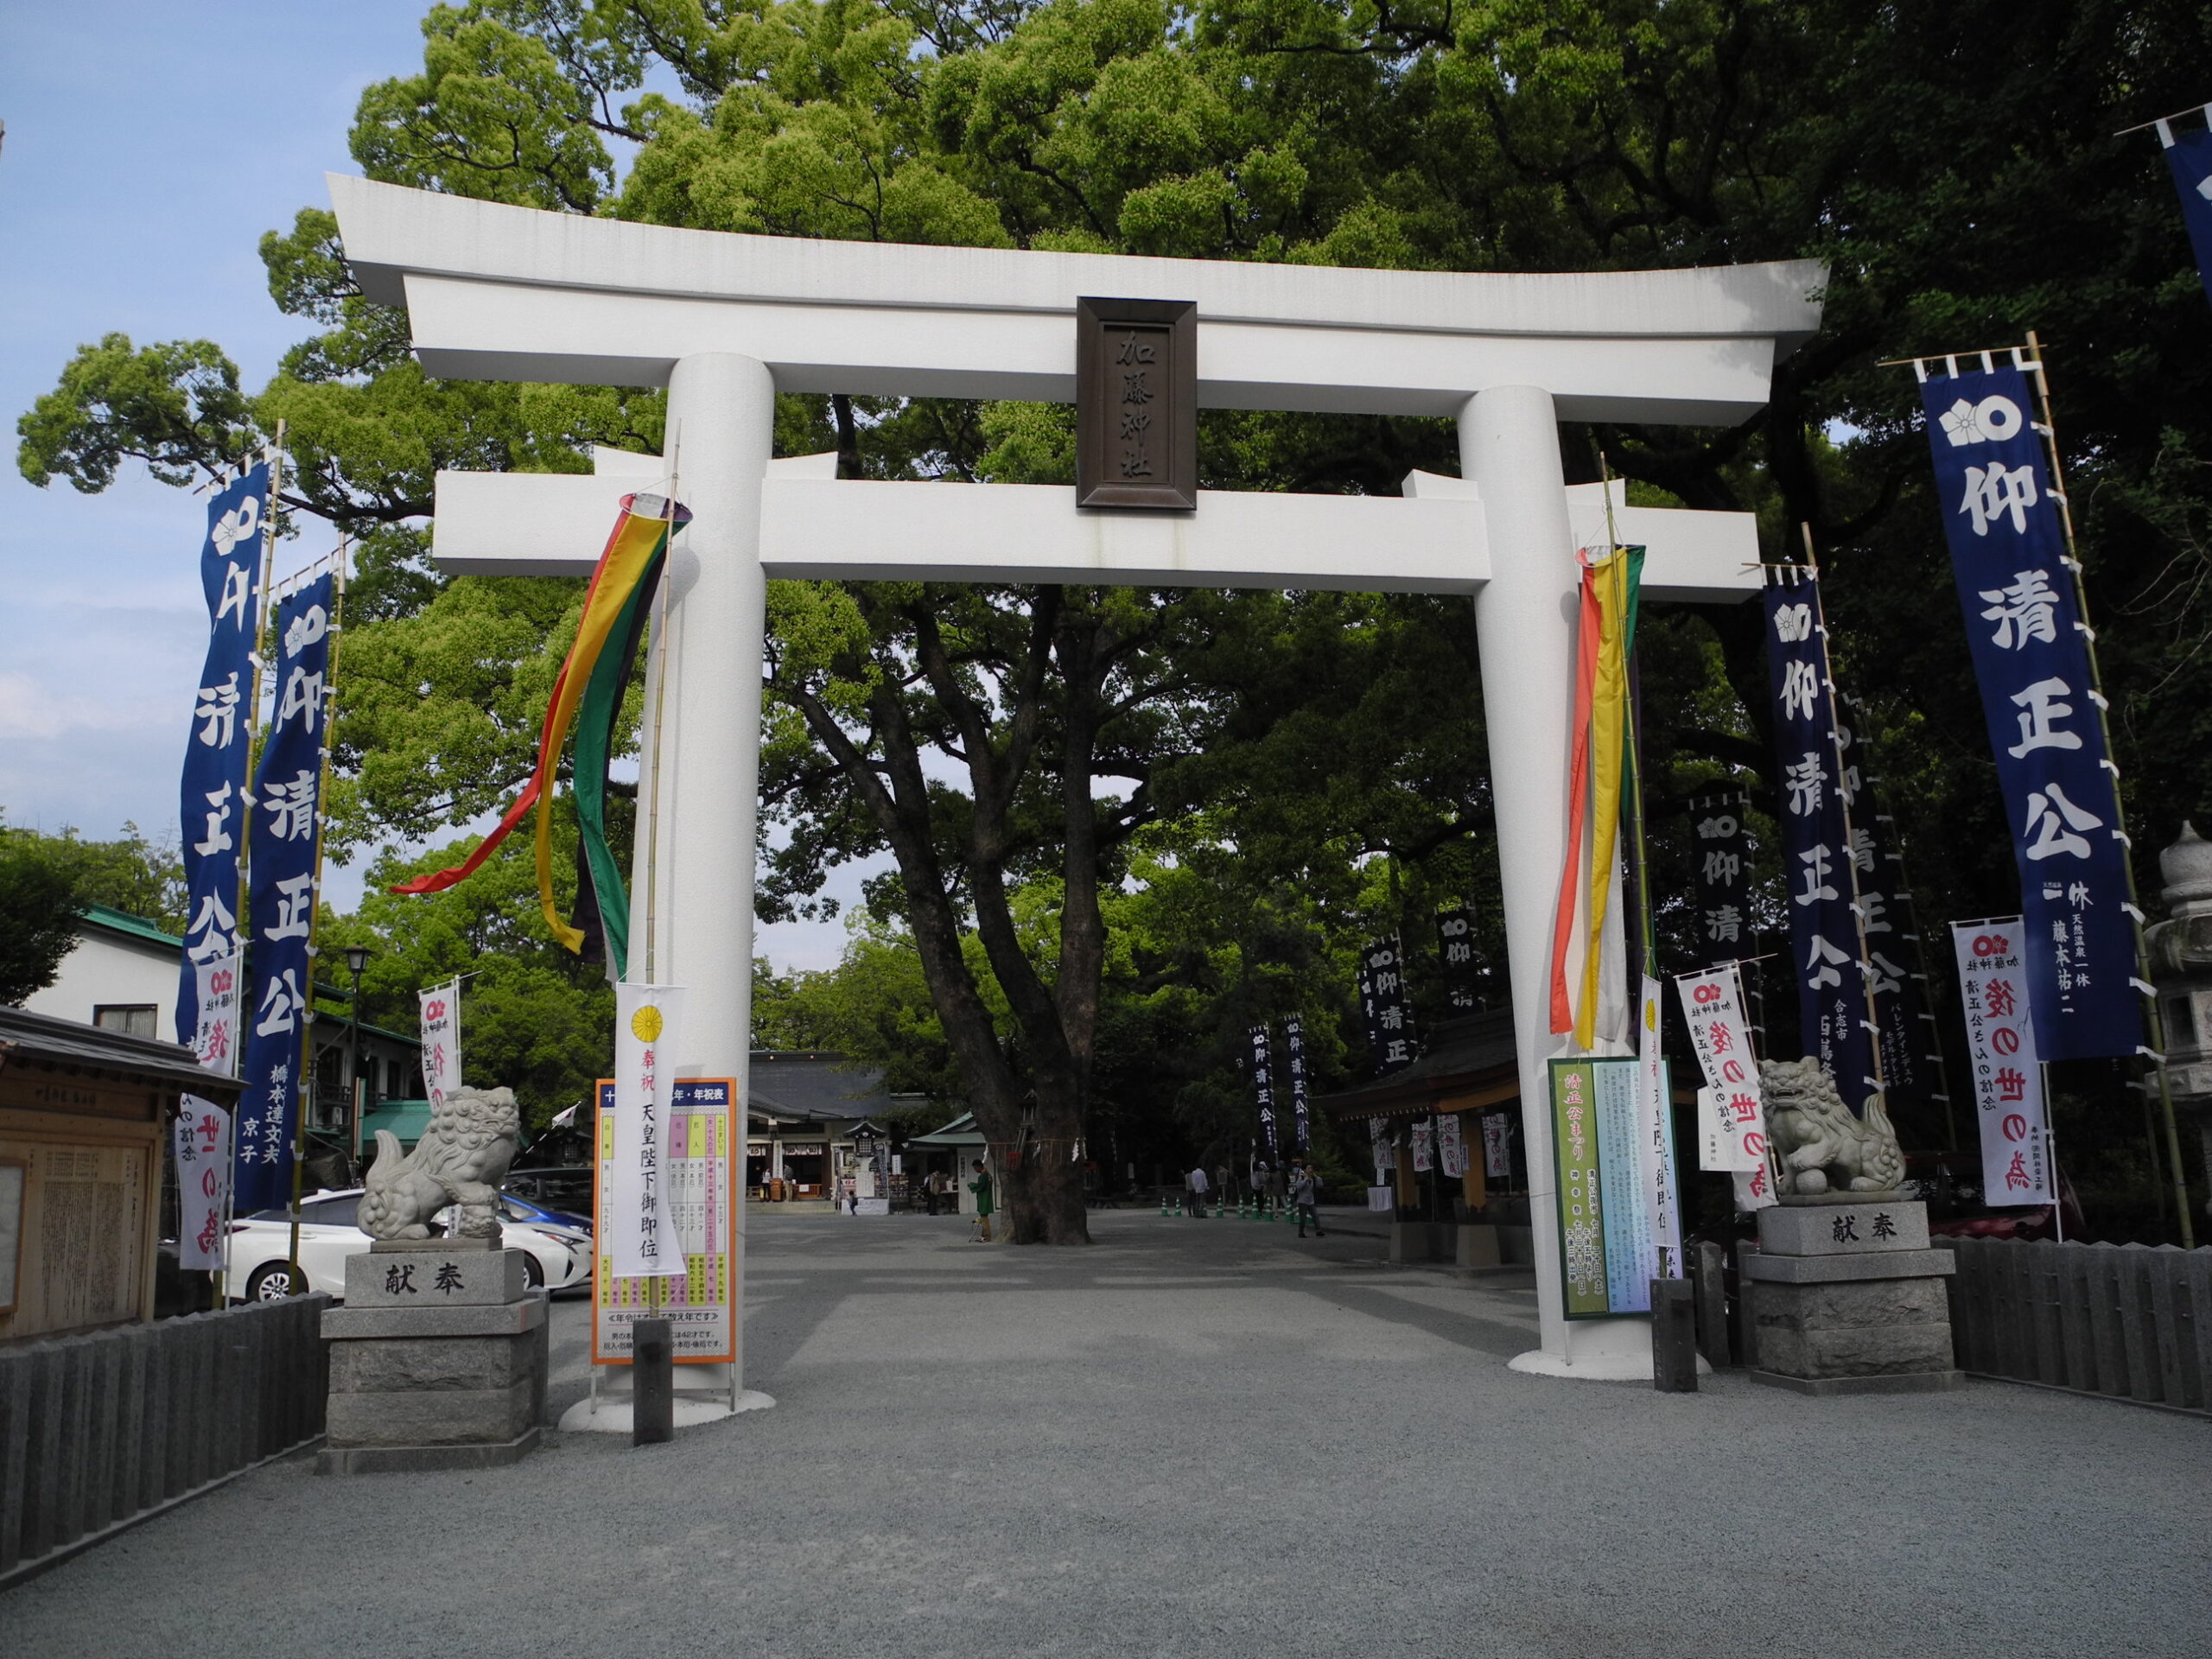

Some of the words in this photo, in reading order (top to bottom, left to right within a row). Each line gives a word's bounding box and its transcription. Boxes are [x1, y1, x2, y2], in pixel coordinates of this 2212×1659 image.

[1116, 330, 1155, 478] 加藤神社
[1958, 461, 2104, 861] 仰清正公
[257, 665, 324, 1037] 仰清正公
[1779, 659, 1851, 990] 仰清正公
[1701, 850, 1743, 969] 仰清
[2072, 913, 2091, 988] 天然温泉一休
[640, 1049, 655, 1091] 奉祝
[1834, 999, 1847, 1041] 合志市
[639, 1104, 658, 1258] 天皇陛下御即位
[1563, 1073, 1585, 1161] 清正公まつり
